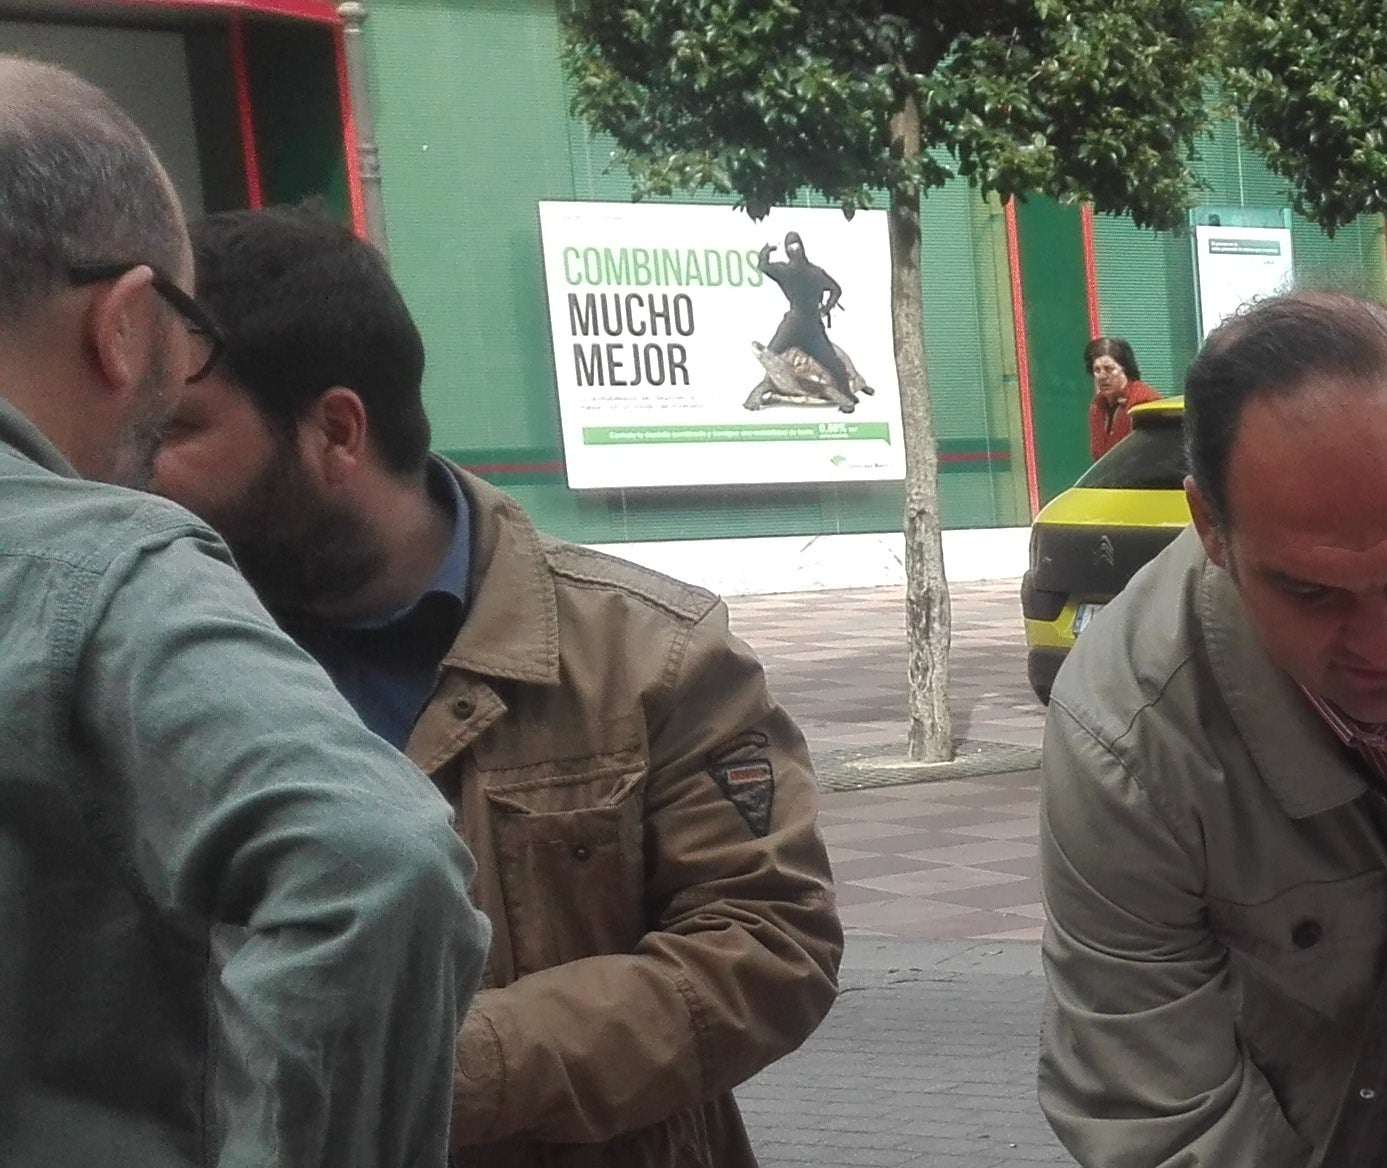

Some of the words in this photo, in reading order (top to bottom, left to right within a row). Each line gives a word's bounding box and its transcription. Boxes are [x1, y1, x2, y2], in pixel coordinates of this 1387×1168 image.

[563, 246, 764, 287] COMBINADOS
[568, 293, 695, 336] MUCHO
[574, 343, 690, 386] MEJOR
